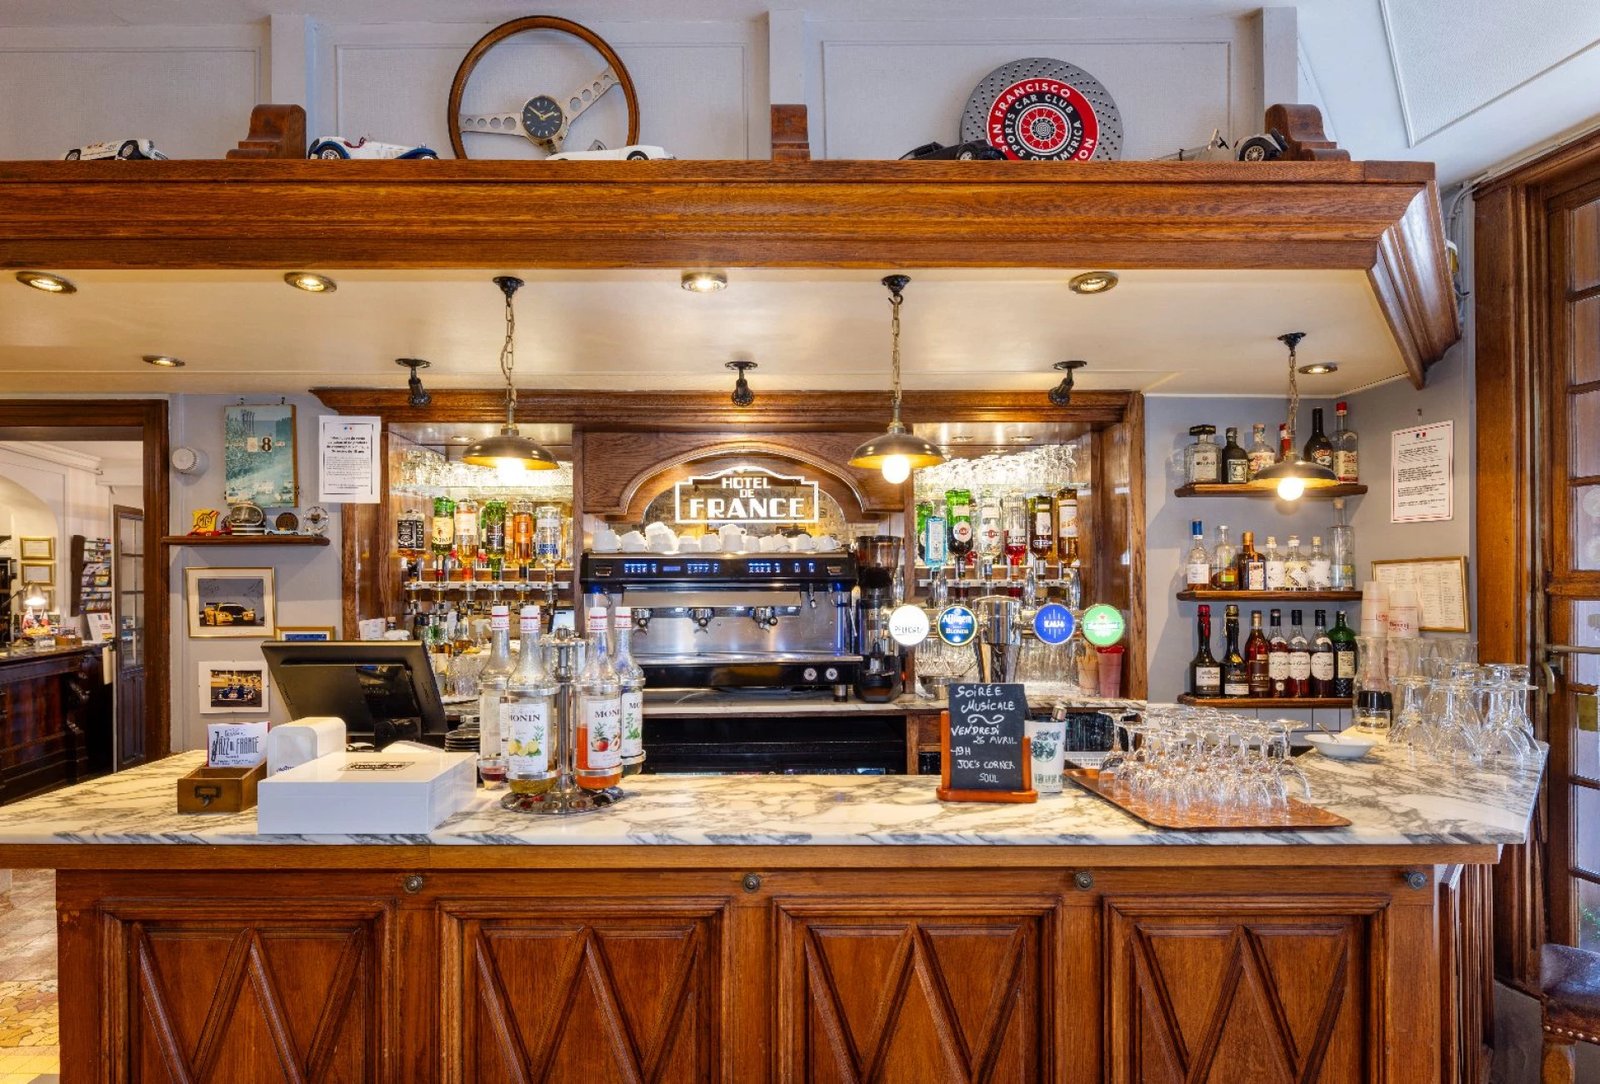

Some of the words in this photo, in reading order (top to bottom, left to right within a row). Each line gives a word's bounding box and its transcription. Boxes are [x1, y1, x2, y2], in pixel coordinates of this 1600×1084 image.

[995, 82, 1072, 117] FRANCISCO
[1014, 94, 1039, 110] CAR
[1044, 94, 1074, 114] CLUB
[992, 123, 1008, 154] SAN
[1005, 112, 1026, 157] SPORTS
[1053, 120, 1082, 161] AMERICA
[261, 437, 272, 452] 8
[721, 477, 771, 489] HOTEL
[739, 488, 755, 498] DE
[689, 498, 805, 518] FRANCE
[594, 707, 620, 719] MONI
[989, 736, 1017, 745] AVRIL
[983, 760, 1016, 770] CORNER
[978, 773, 999, 783] SOUL
